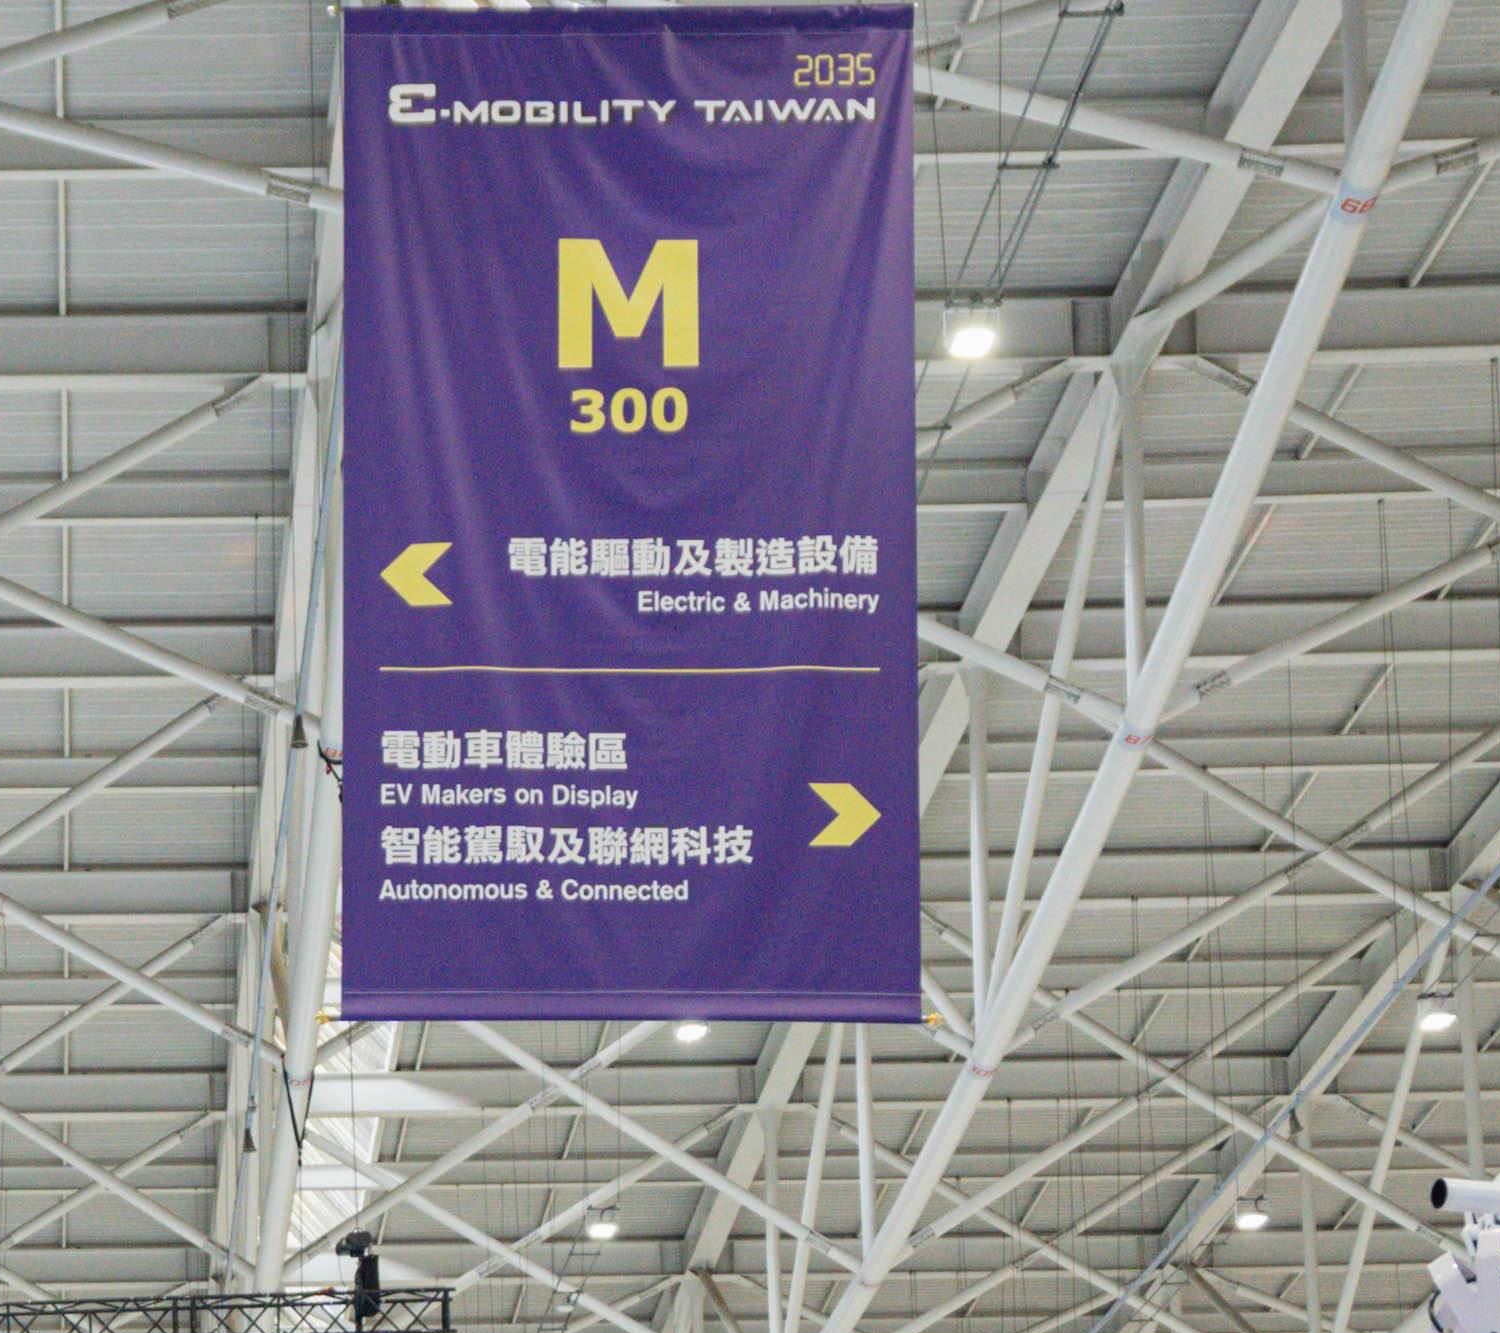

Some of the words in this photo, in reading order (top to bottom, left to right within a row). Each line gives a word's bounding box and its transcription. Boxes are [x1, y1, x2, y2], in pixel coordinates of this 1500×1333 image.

[794, 53, 876, 87] 2035
[388, 83, 676, 125] E-MOBILITY
[694, 97, 876, 124] TAIWAN
[558, 238, 699, 369] M
[570, 388, 688, 433] 300
[507, 535, 879, 577] 電能驅動及製造設備
[637, 591, 725, 612] Electric
[733, 592, 751, 612] &
[759, 589, 879, 614] Machinery
[380, 731, 628, 771] 電動車體驗區
[380, 784, 413, 805] EV
[421, 784, 507, 806] Makers
[515, 789, 544, 806] on
[552, 785, 638, 809] Display
[380, 825, 754, 866] 智能駕馭及聯網科技
[379, 880, 528, 901] Autonomous
[536, 880, 554, 901] &
[561, 880, 690, 901] Connected
